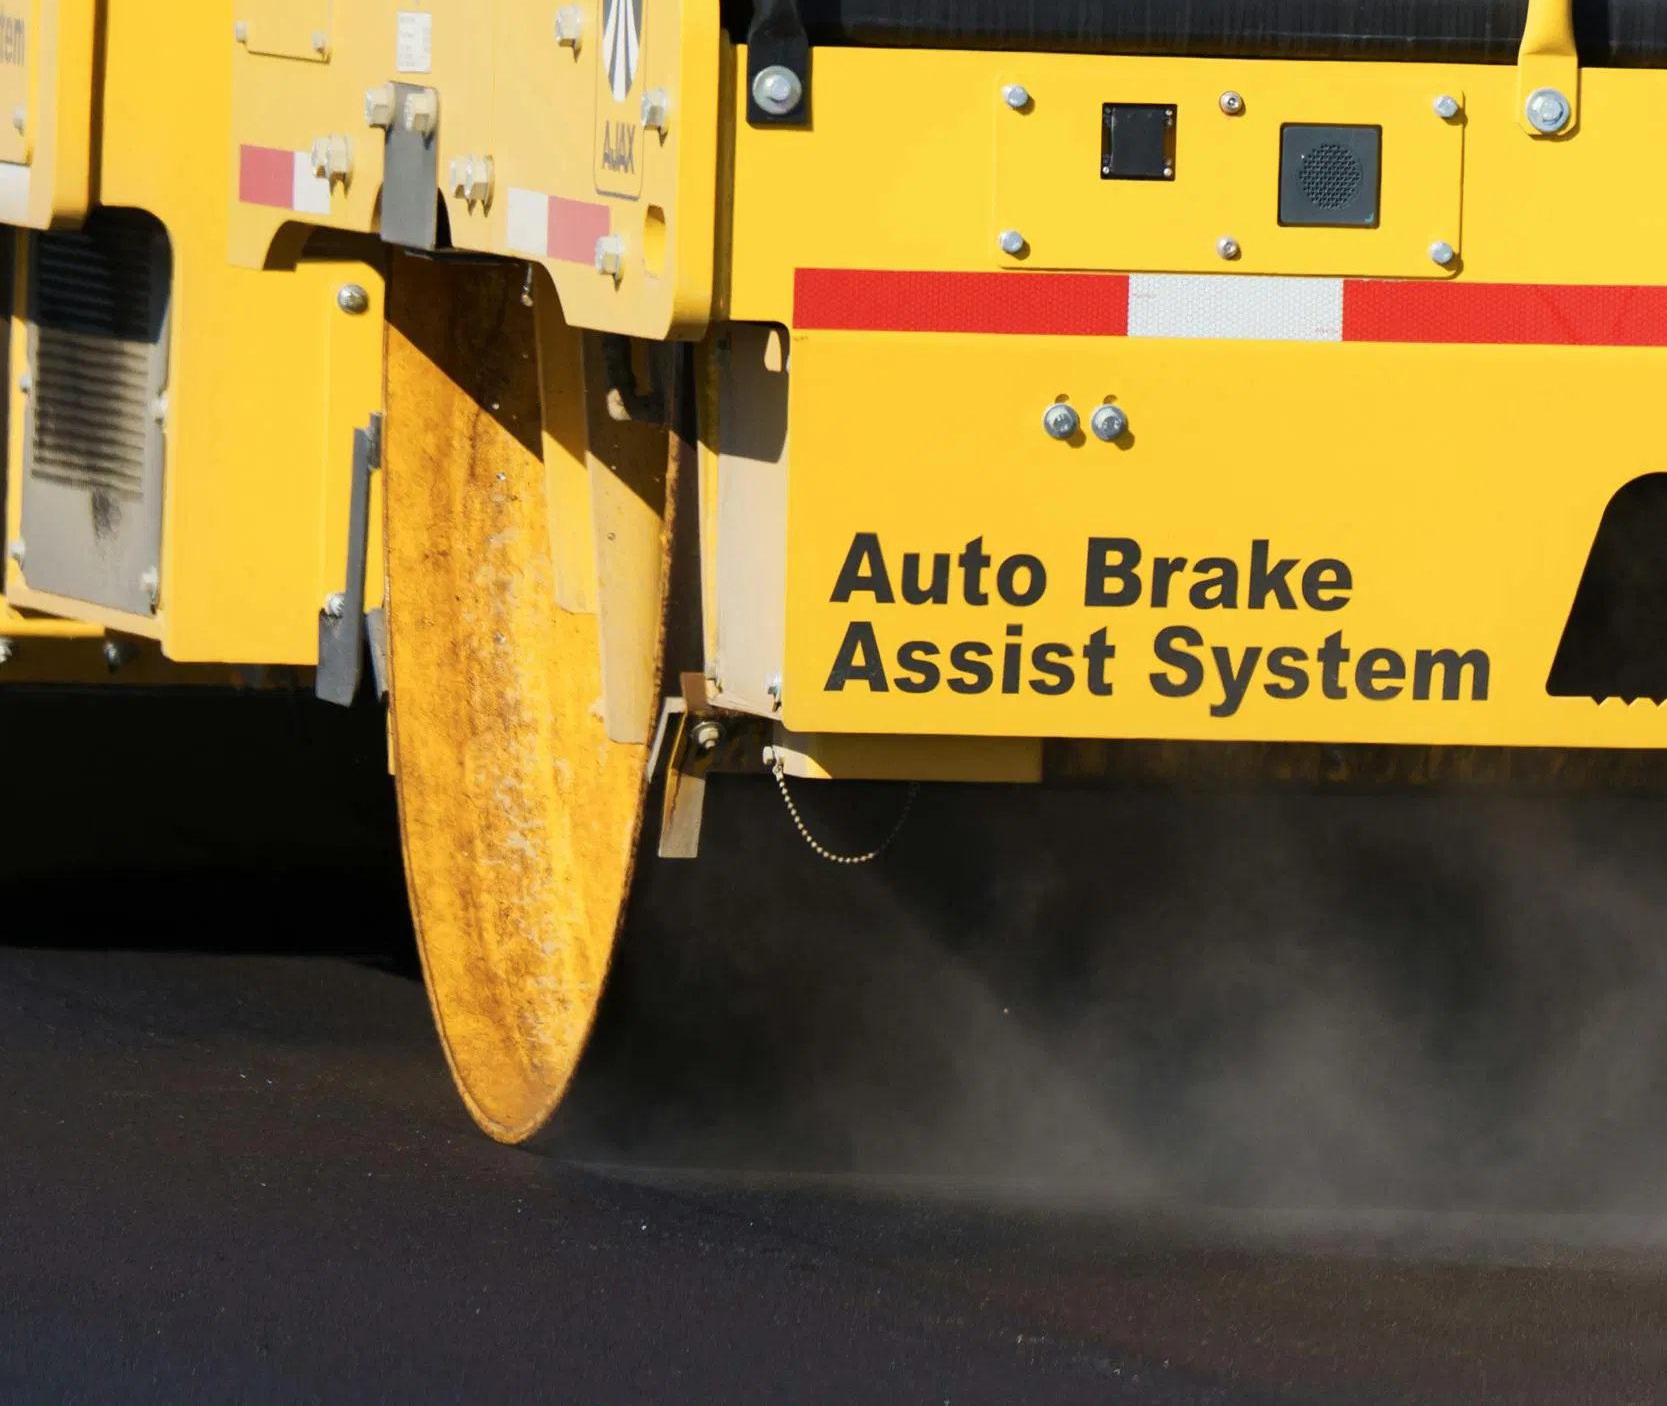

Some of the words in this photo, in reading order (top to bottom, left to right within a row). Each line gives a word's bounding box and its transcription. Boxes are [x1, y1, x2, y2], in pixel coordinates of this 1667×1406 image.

[601, 121, 636, 176] AJAX
[829, 532, 1048, 608] Auto
[1083, 536, 1354, 612] Brake
[823, 621, 1117, 697] Assist
[1148, 624, 1491, 719] System
